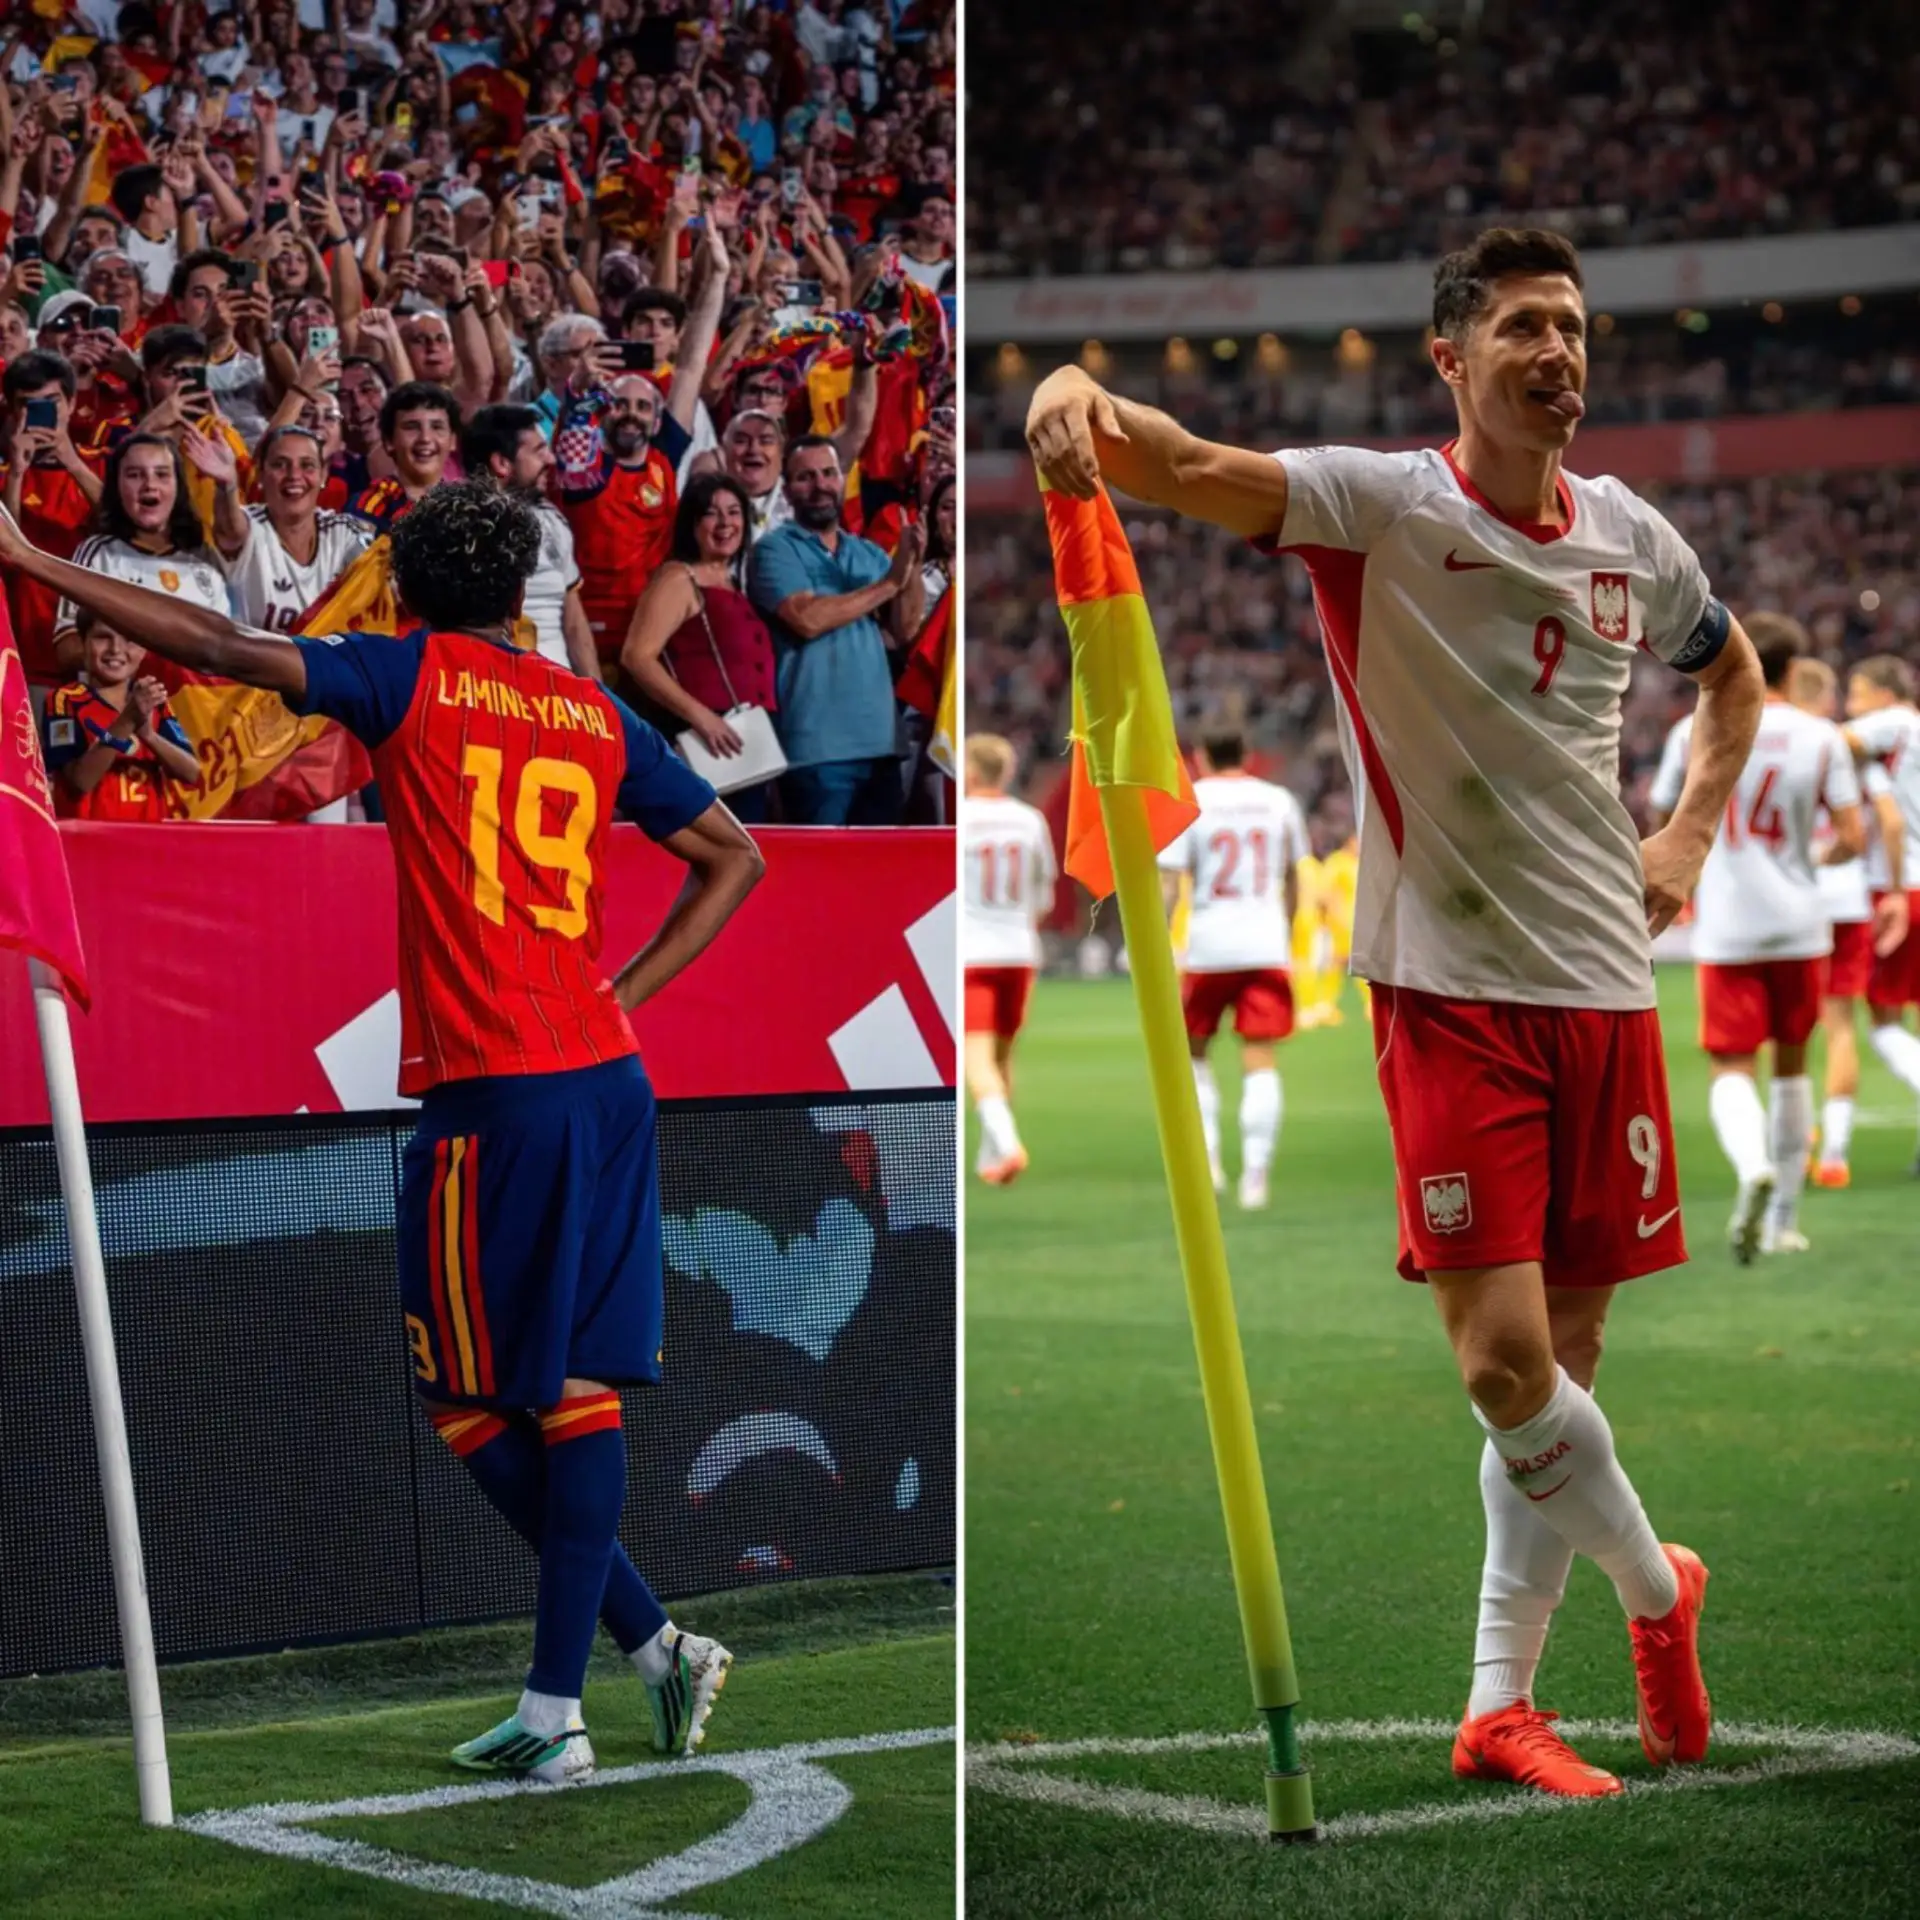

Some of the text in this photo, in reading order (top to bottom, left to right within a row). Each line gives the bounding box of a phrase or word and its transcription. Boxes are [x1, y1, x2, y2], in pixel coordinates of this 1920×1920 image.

[1531, 615, 1566, 698] 9
[437, 669, 615, 741] LAMINE YAMAL
[120, 766, 148, 802] 12
[1723, 764, 1787, 853] 14
[463, 744, 597, 940] 19
[979, 842, 1021, 904] 11
[1210, 828, 1270, 899] 21
[1628, 1114, 1661, 1199] 9
[1504, 1441, 1572, 1475] POLSKA
